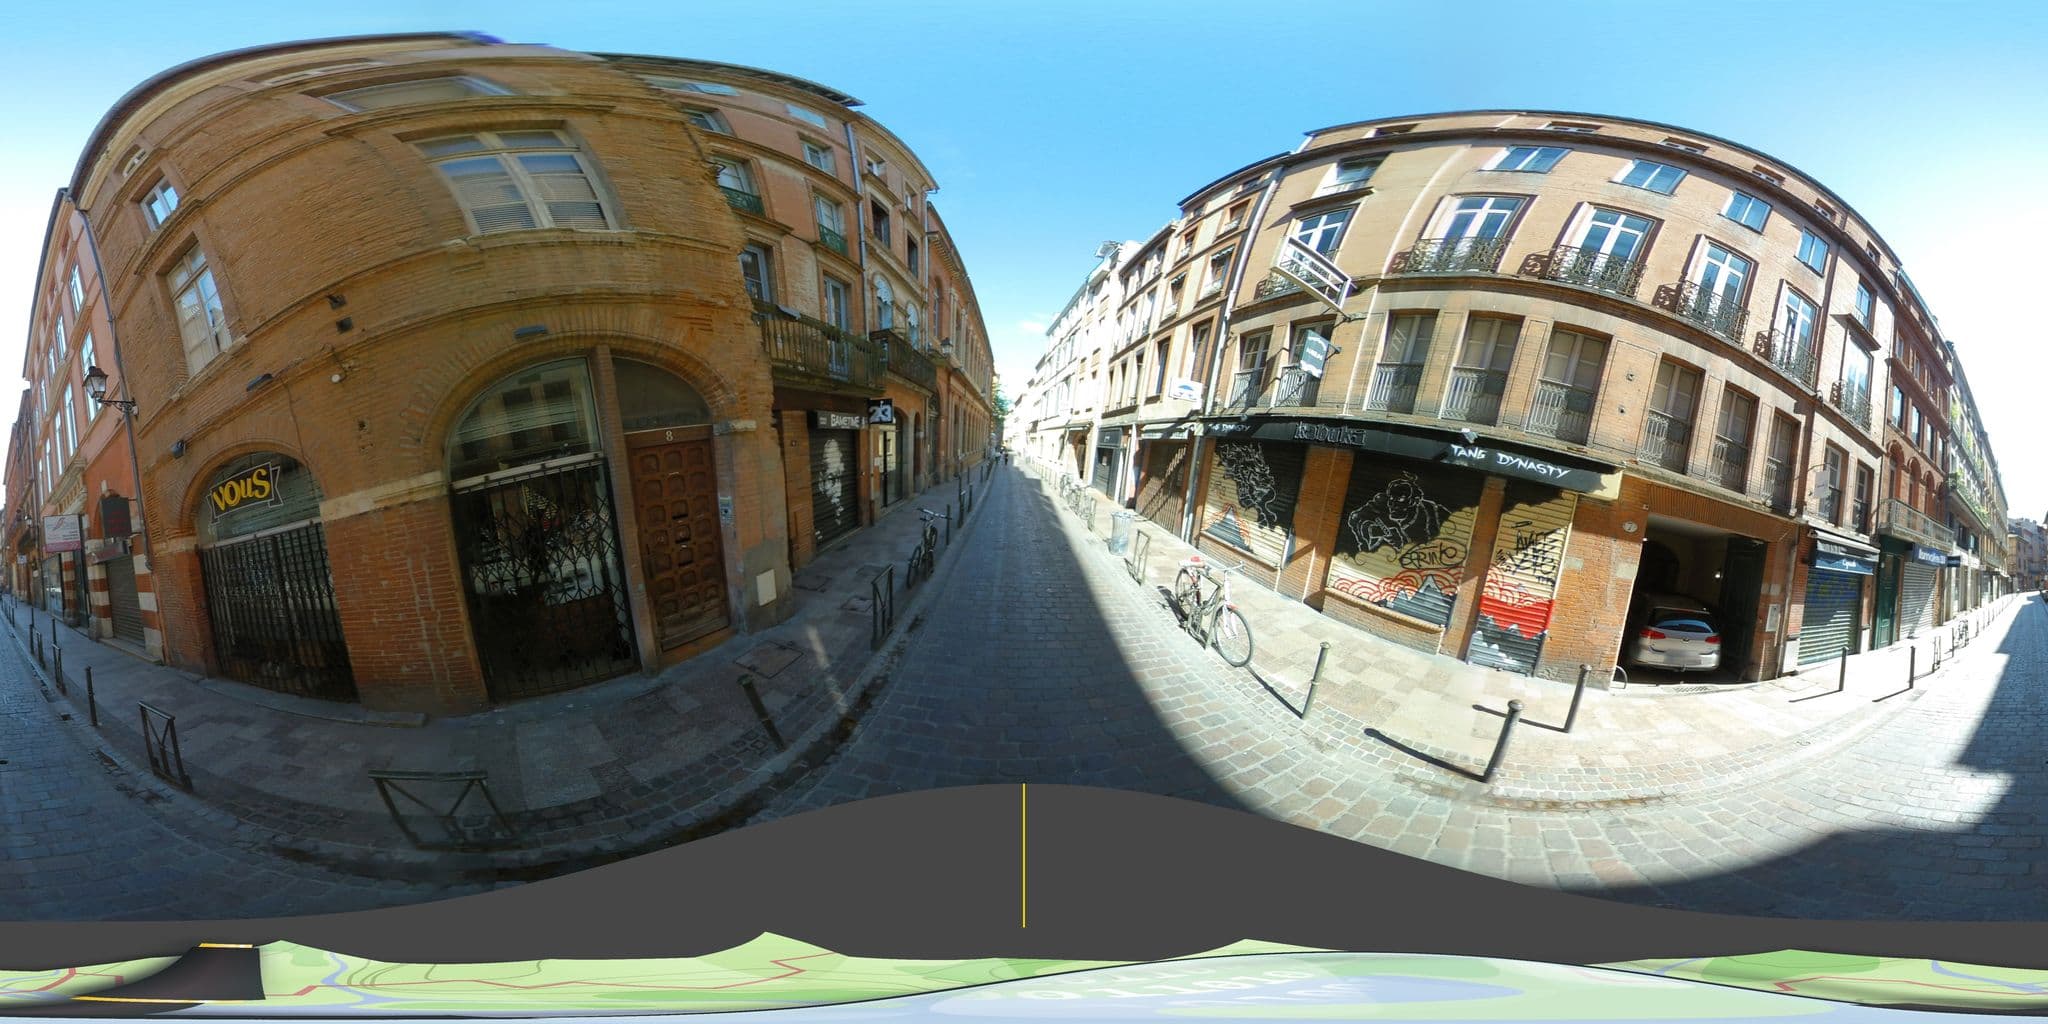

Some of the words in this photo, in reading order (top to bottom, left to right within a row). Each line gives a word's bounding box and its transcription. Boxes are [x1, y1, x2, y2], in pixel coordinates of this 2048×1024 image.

[665, 431, 673, 441] 8
[1450, 443, 1488, 460] TANG
[1497, 452, 1572, 479] DYNASTY
